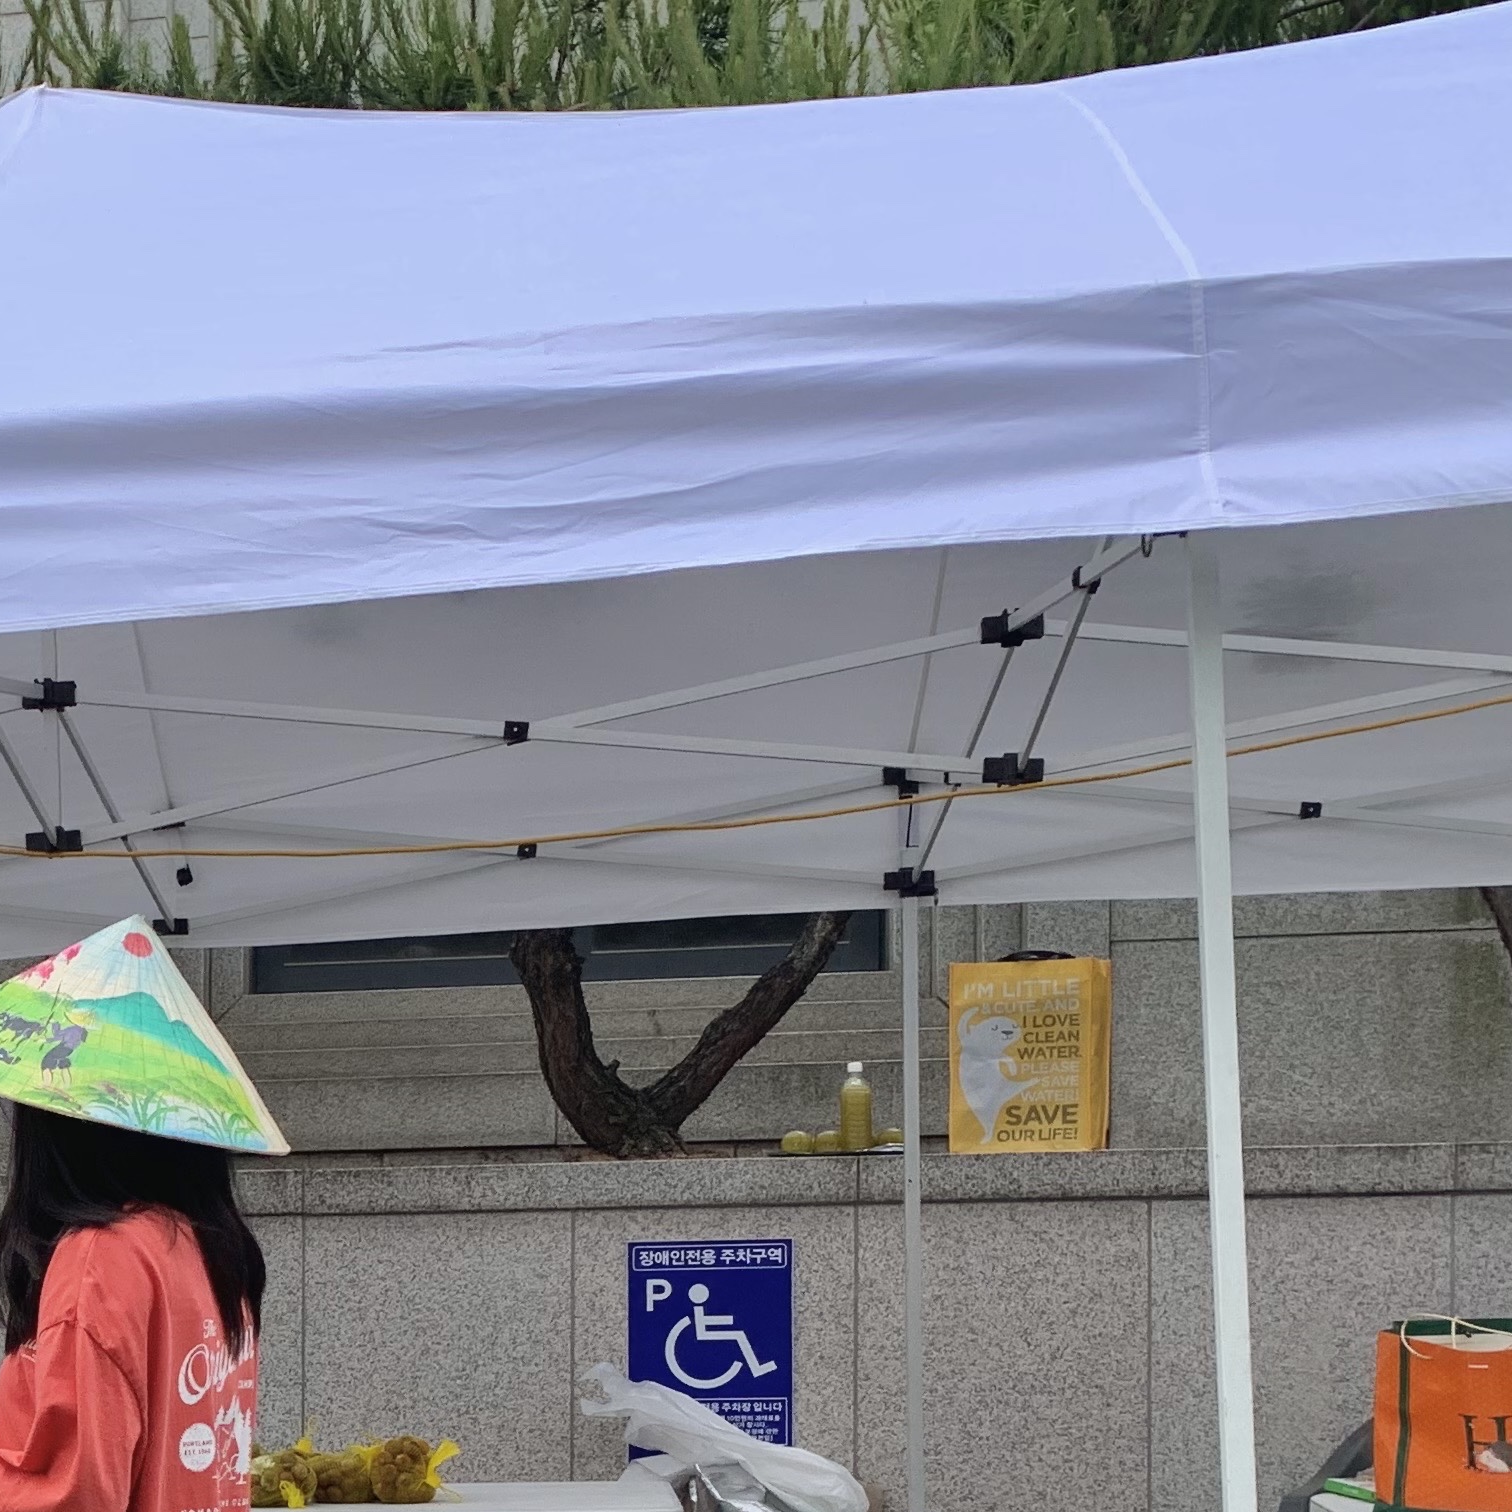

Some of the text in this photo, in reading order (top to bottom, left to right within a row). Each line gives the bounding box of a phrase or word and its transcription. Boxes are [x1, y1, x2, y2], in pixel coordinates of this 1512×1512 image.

[1002, 978, 1080, 998] LITTLE
[1042, 999, 1080, 1012] AND
[1022, 1013, 1081, 1029] I LOVE
[1023, 1030, 1080, 1044] CLEAN
[1021, 1060, 1080, 1075] PLEASE
[1040, 1075, 1079, 1087] SAVE
[1005, 1104, 1079, 1126] SAVE
[996, 1127, 1078, 1142] OUR LIFE!
[638, 1247, 783, 1267] 장애인전용 주차구역
[646, 1278, 673, 1312] P
[721, 1402, 751, 1413] 주차장
[753, 1402, 782, 1412] 입니다
